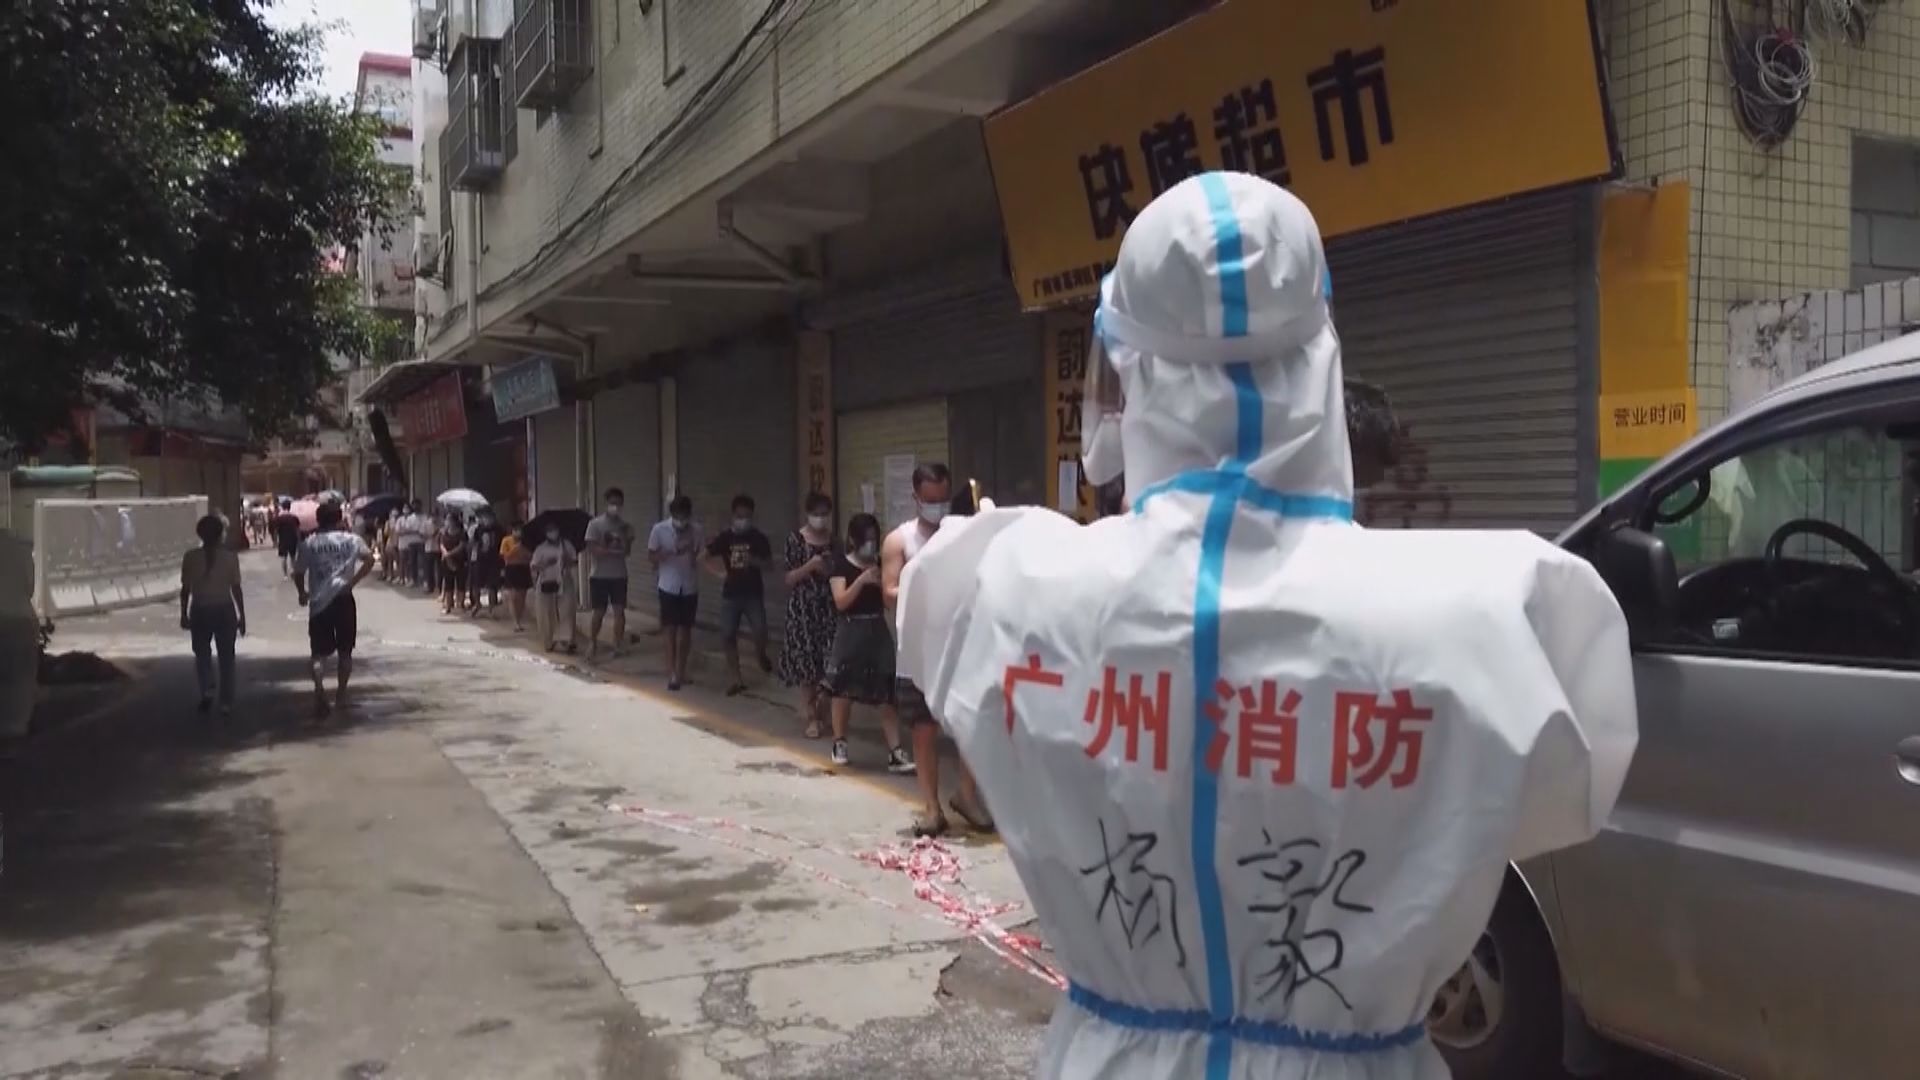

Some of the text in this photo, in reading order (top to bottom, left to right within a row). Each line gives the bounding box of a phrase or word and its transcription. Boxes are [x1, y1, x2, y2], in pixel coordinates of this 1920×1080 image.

[1614, 403, 1686, 427] 营业时间
[1003, 654, 1433, 790] 广州消防
